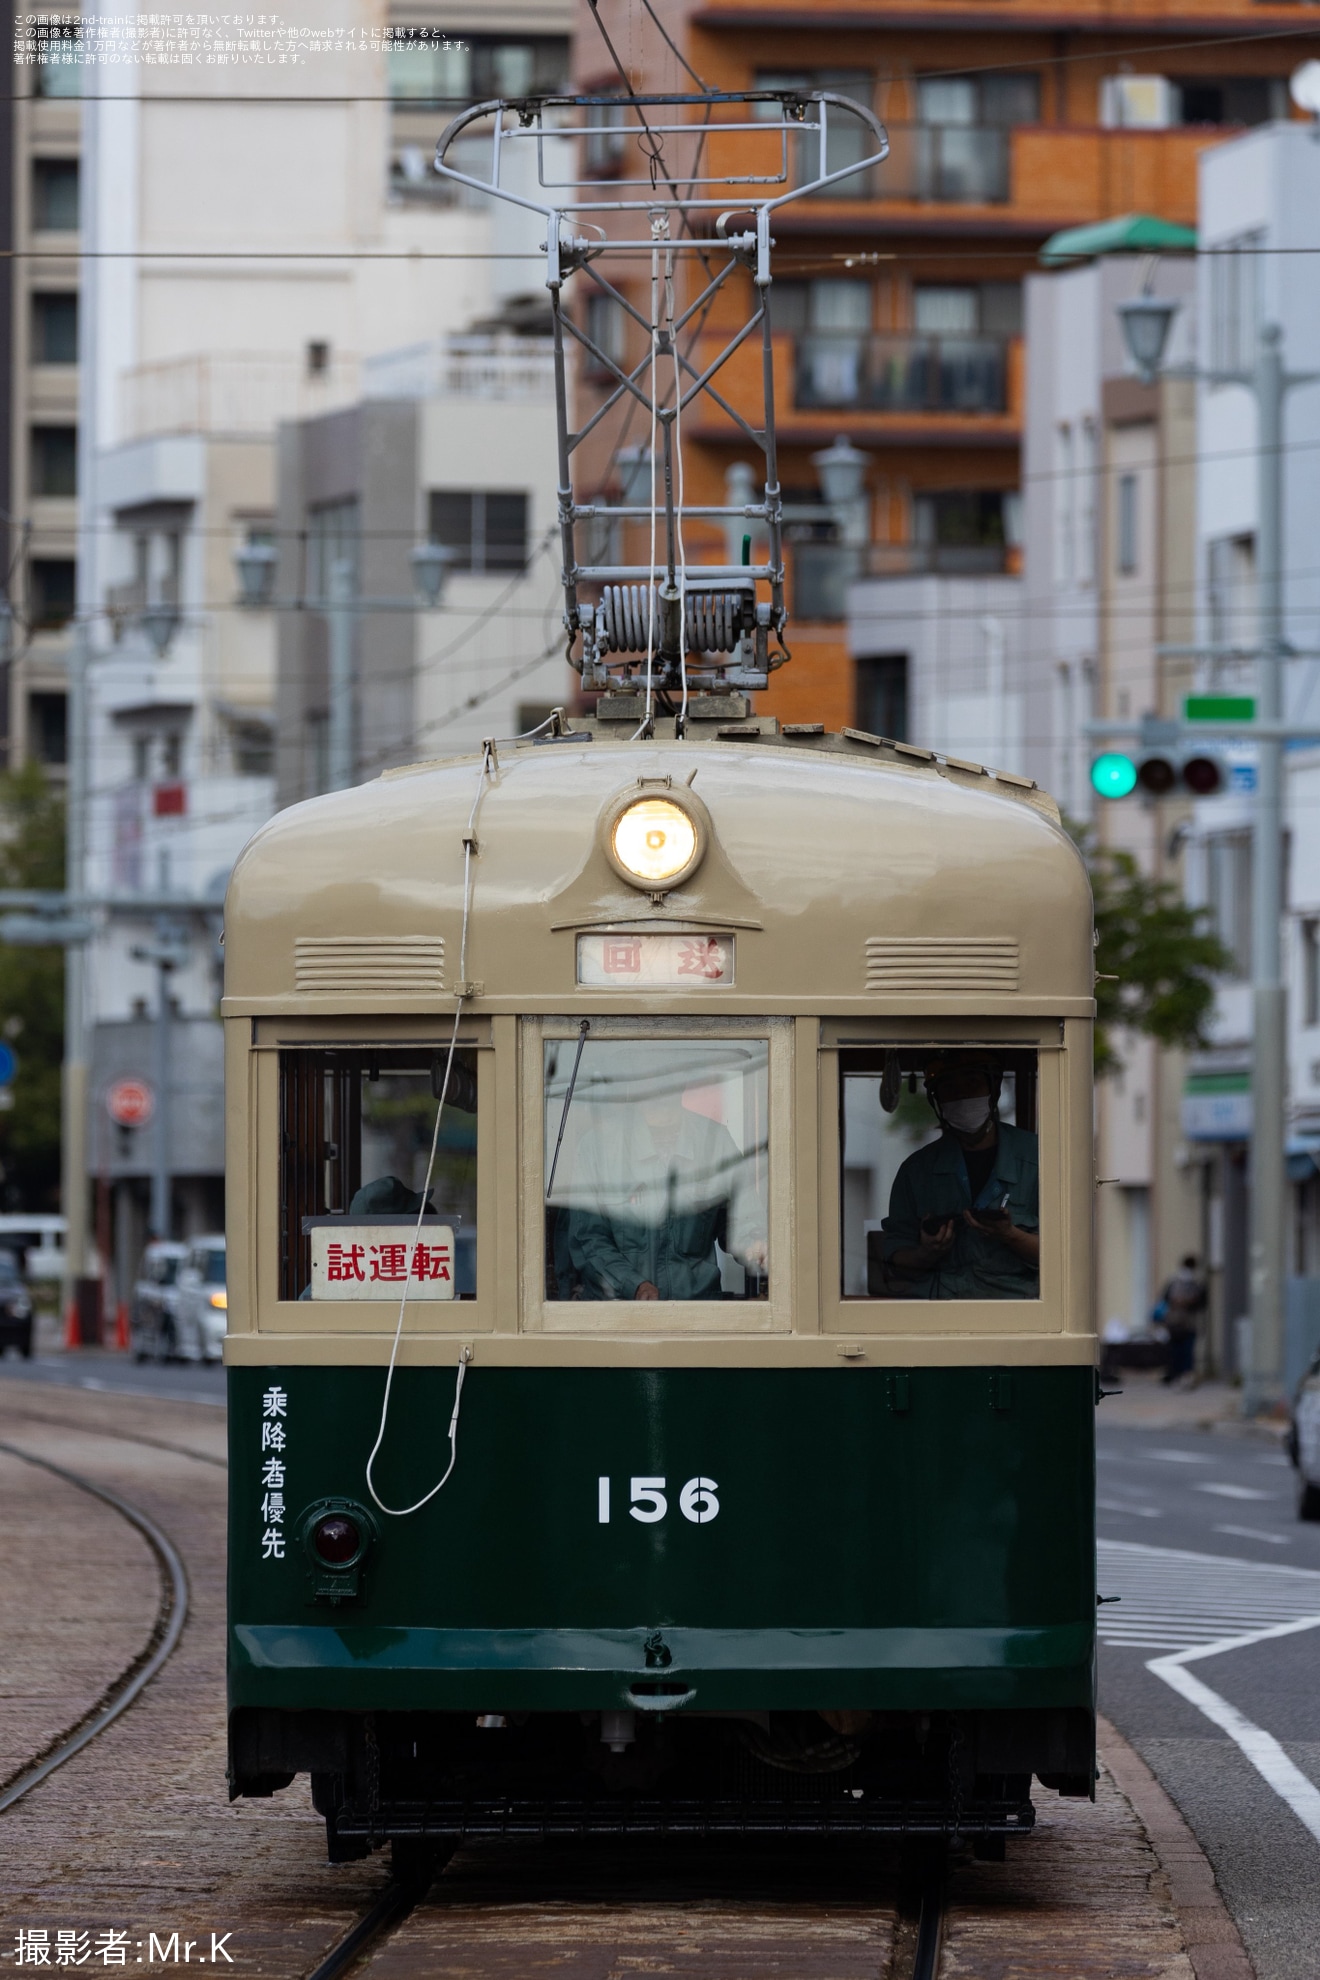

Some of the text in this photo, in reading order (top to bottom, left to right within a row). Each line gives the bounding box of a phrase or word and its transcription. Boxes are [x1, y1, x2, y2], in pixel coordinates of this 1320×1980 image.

[602, 938, 724, 979] 回送
[327, 1243, 451, 1282] 試運転
[260, 1386, 288, 1559] 乗降者優先
[598, 1476, 720, 1524] 156
